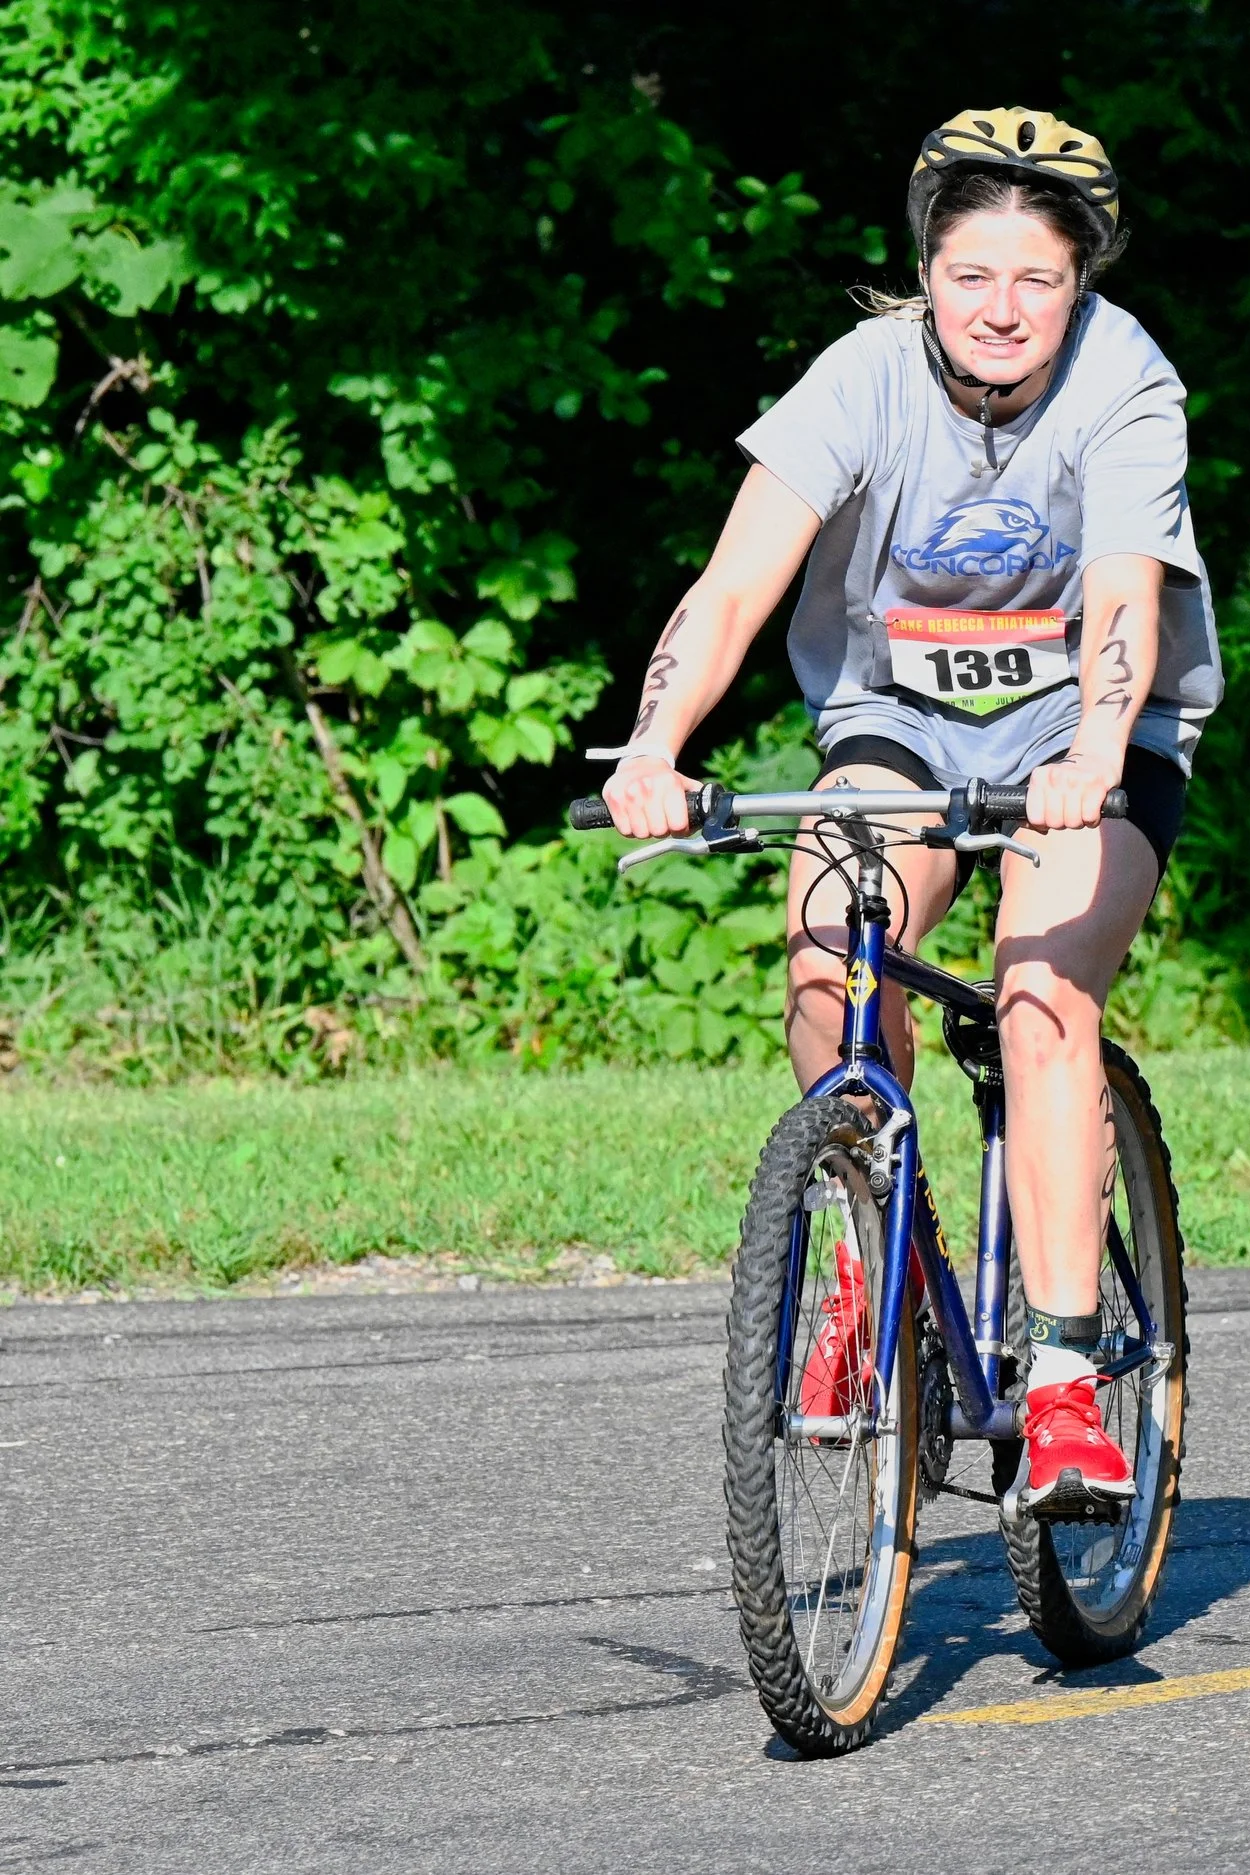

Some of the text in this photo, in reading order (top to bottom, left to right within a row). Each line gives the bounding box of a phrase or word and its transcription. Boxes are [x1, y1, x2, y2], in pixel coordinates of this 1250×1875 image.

[890, 541, 1077, 577] CONCORDA
[927, 617, 985, 633] REBECCA
[989, 616, 1058, 632] TRIATHLON
[924, 647, 1033, 692] 139
[1095, 604, 1133, 720] 139
[995, 696, 1015, 706] JULY
